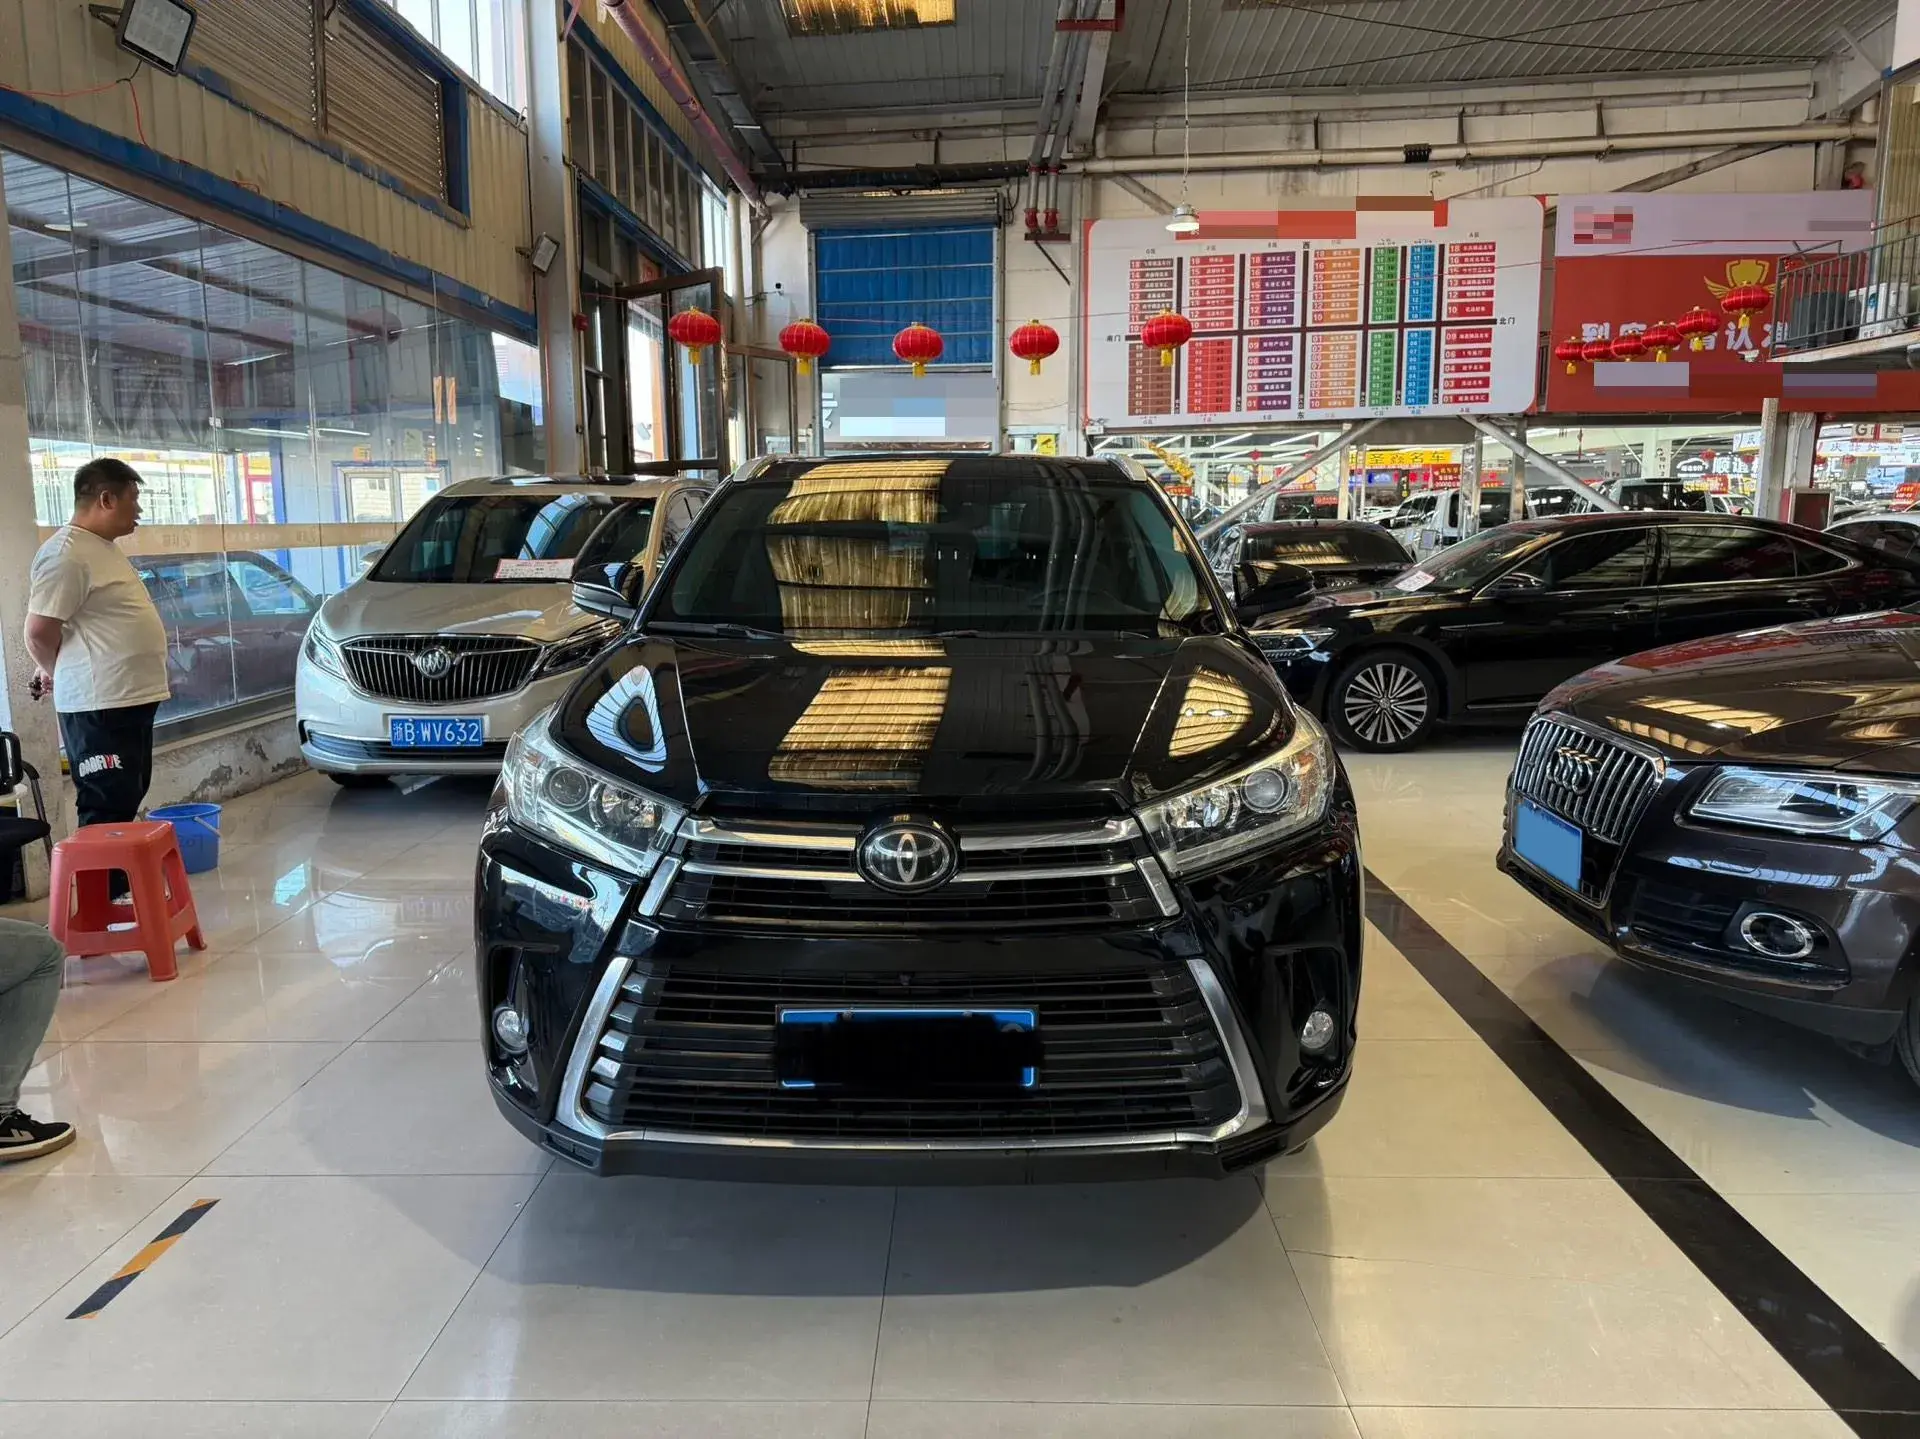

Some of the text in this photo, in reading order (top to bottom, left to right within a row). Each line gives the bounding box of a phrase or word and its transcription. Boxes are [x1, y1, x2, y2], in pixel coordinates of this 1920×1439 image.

[1448, 306, 1458, 314] 10
[1500, 317, 1515, 325] 北门
[1297, 411, 1304, 419] 东
